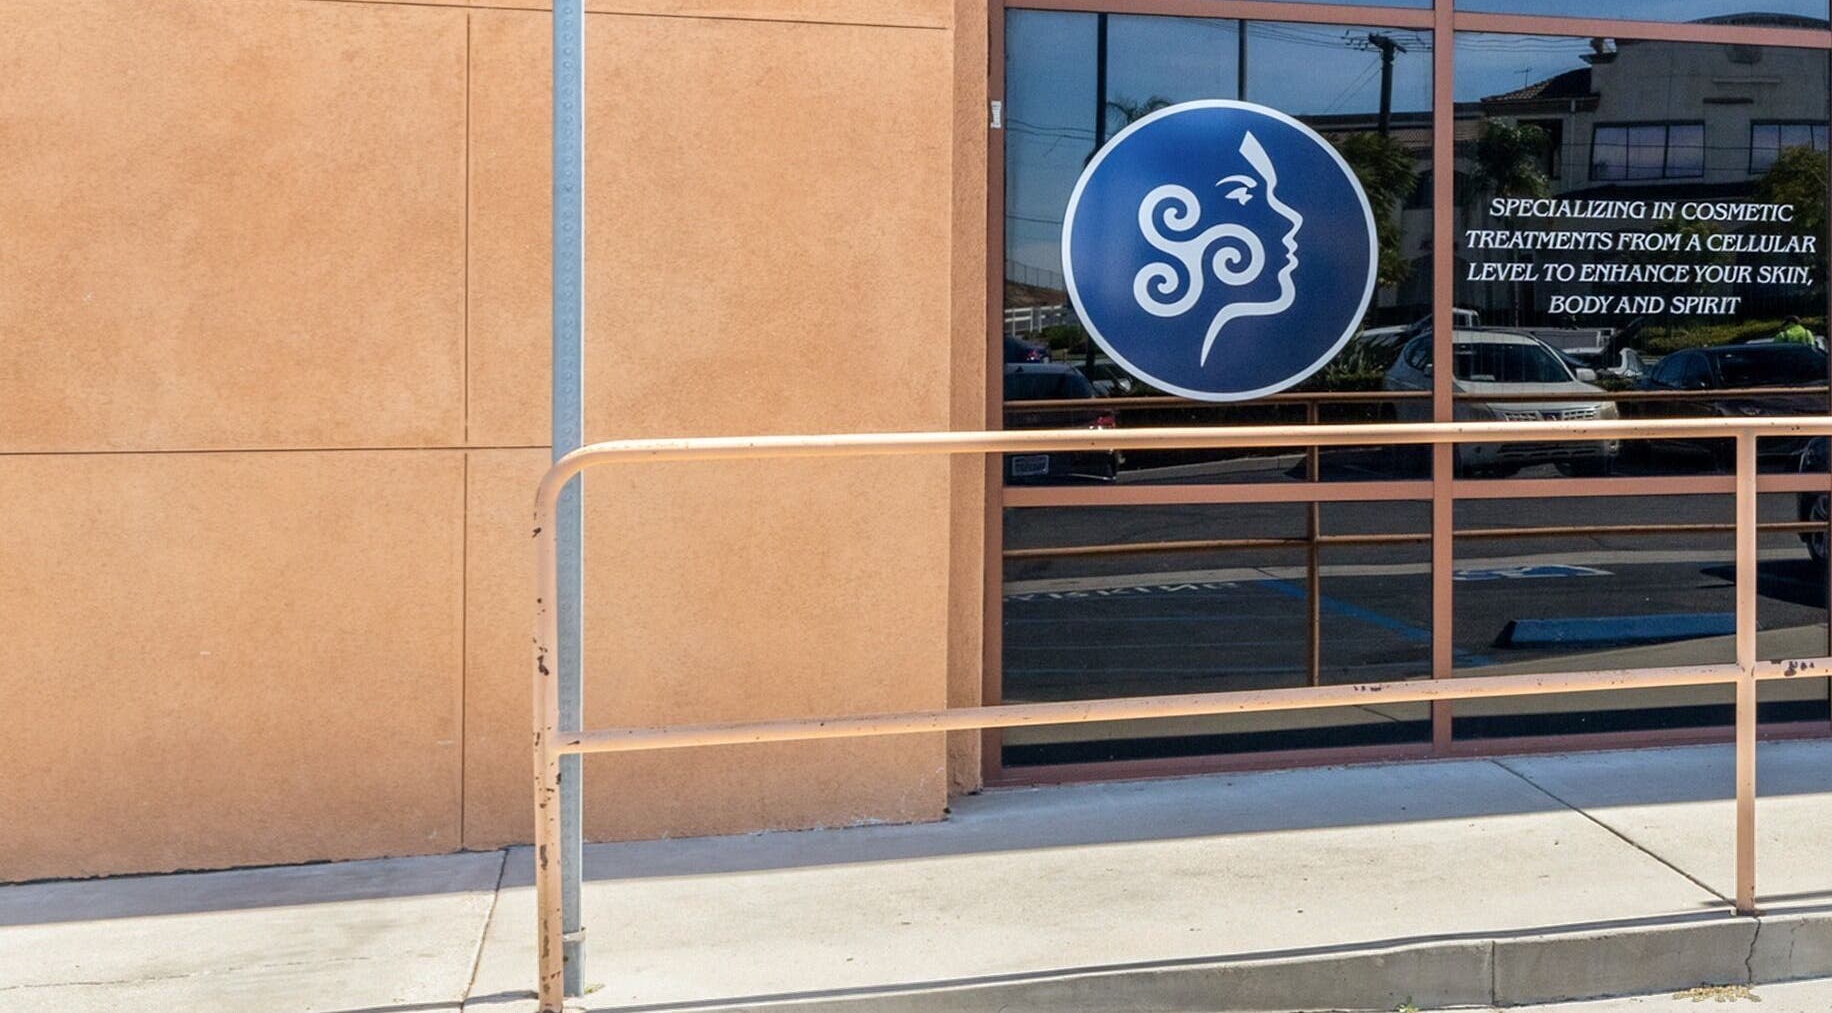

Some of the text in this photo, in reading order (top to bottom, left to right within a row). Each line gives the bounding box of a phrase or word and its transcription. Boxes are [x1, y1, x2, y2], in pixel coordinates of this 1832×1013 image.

[1489, 198, 1794, 222] SPECIALIZING IN COSMETIC
[1465, 230, 1816, 253] TREATMENTS FROM A CELLULAR
[1467, 262, 1814, 287] LEVEL TO ENHANCE YOUR SKIN,
[1548, 295, 1741, 315] BODY AND SPIRIT
